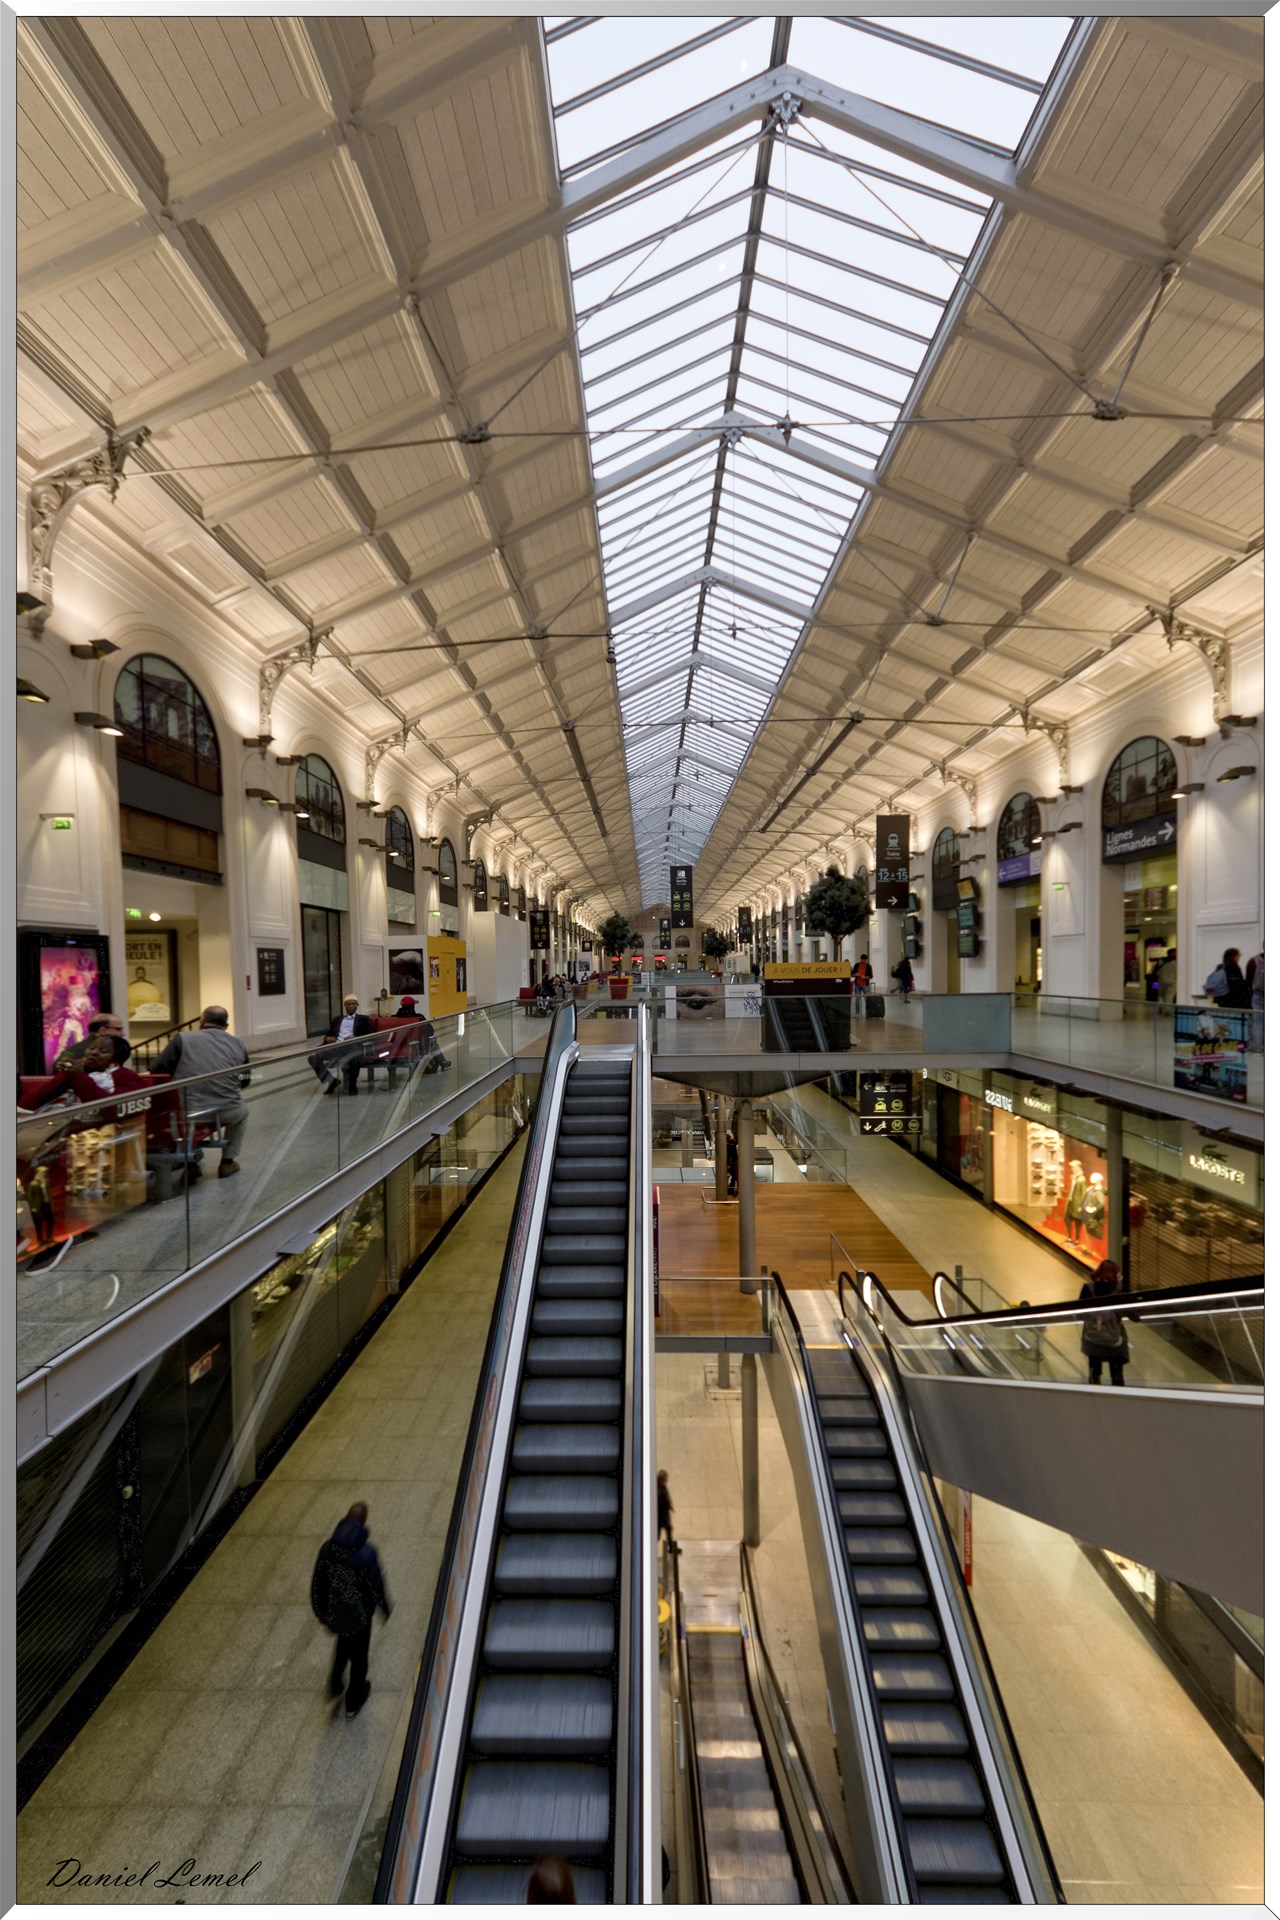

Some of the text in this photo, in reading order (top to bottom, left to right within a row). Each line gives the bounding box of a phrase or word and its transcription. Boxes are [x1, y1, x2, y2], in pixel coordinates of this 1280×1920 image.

[1106, 828, 1134, 844] Lignes
[1106, 835, 1158, 856] Normandes
[878, 871, 890, 881] 12
[897, 871, 908, 881] 15
[147, 942, 161, 951] EN
[1189, 1154, 1245, 1185] LACOSTE
